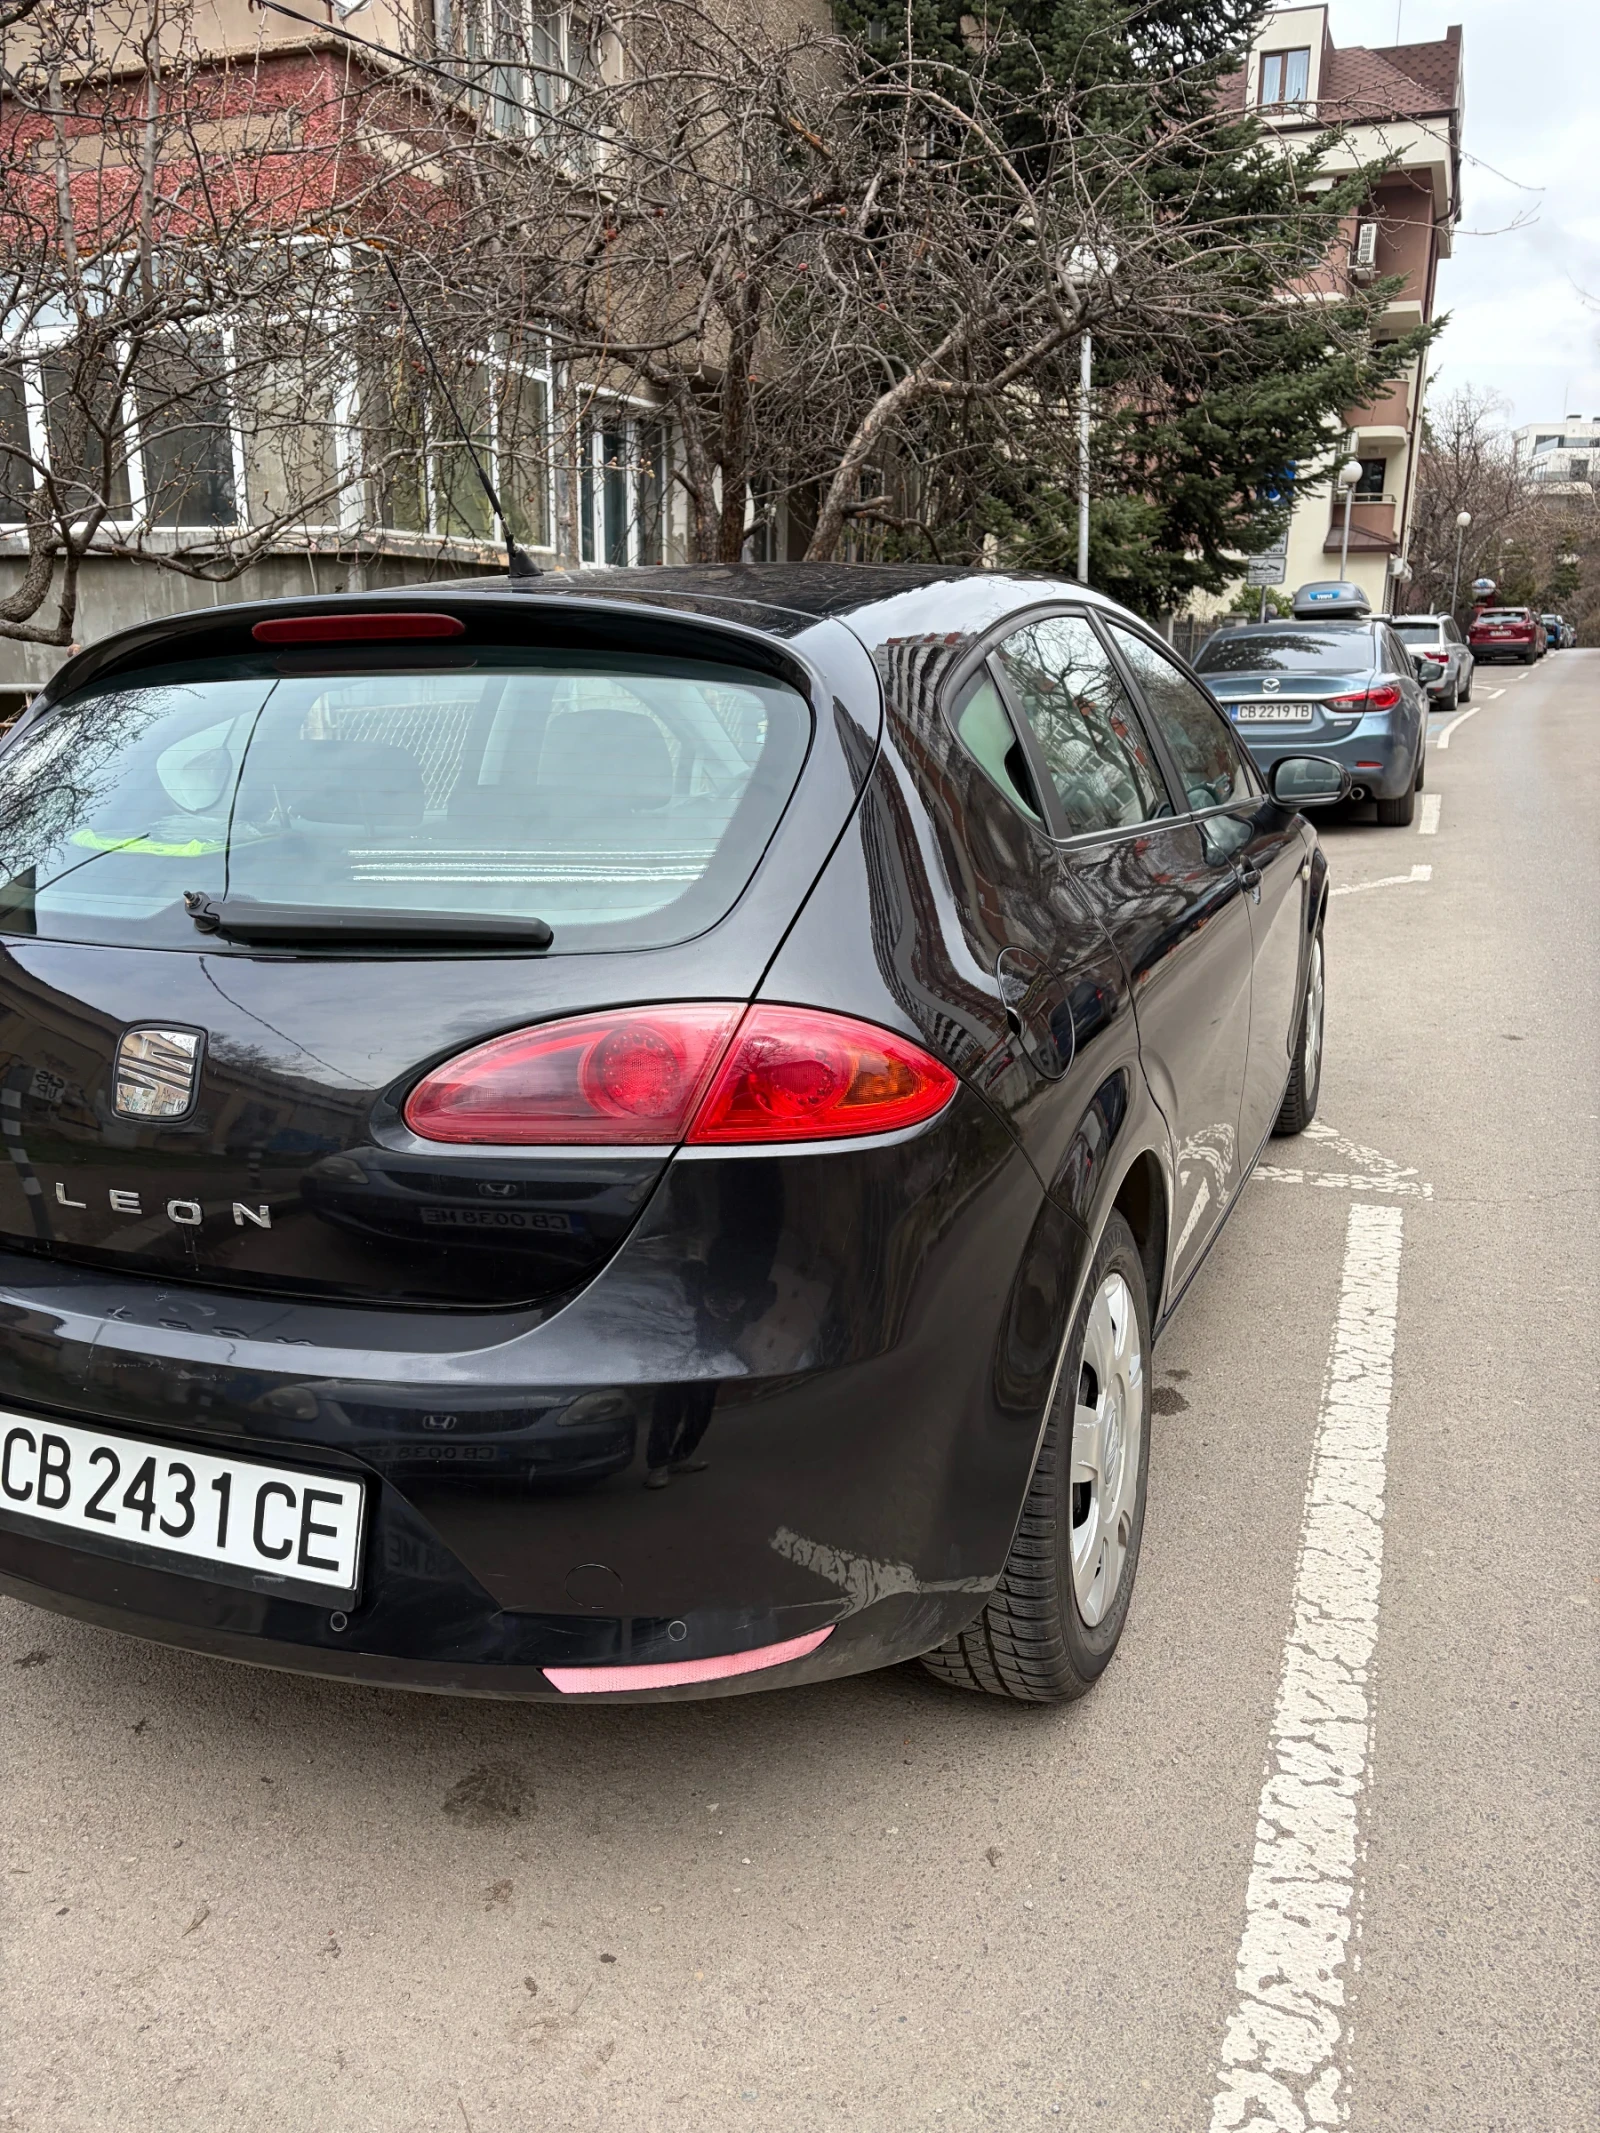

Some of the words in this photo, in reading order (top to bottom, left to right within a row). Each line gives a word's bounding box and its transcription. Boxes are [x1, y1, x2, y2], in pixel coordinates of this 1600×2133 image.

[1240, 705, 1257, 718] CB
[1259, 705, 1291, 718] 2219
[1293, 704, 1310, 717] TB
[56, 1182, 272, 1229] LEON
[1, 1427, 72, 1510] CB
[84, 1447, 232, 1549] 2431
[252, 1481, 344, 1571] CE
